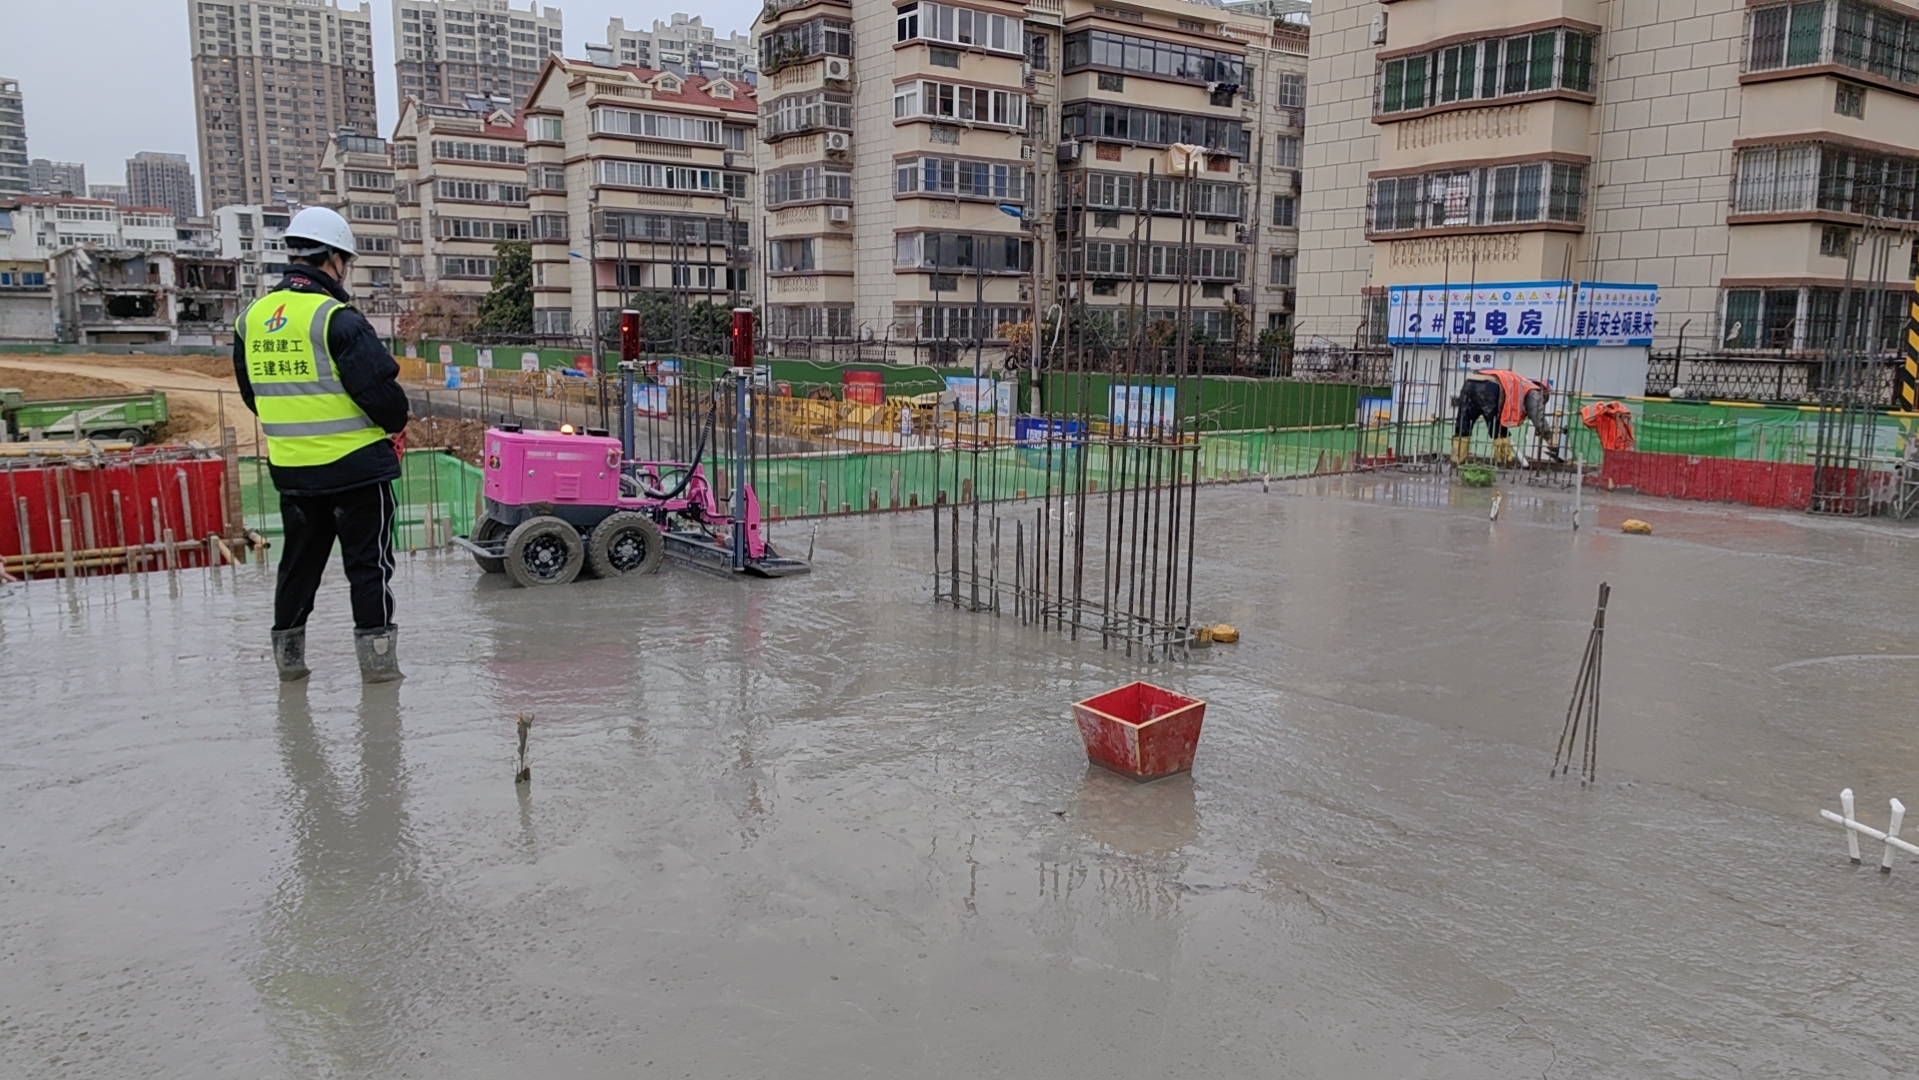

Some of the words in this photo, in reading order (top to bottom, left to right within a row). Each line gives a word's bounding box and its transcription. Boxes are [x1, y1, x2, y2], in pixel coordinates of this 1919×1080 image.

[1408, 309, 1543, 336] 2#配电房
[1574, 310, 1653, 337] 重视安全硕果来
[252, 339, 303, 353] 安徽建工
[1462, 353, 1492, 364] 配电房
[252, 360, 310, 376] 三建科技
